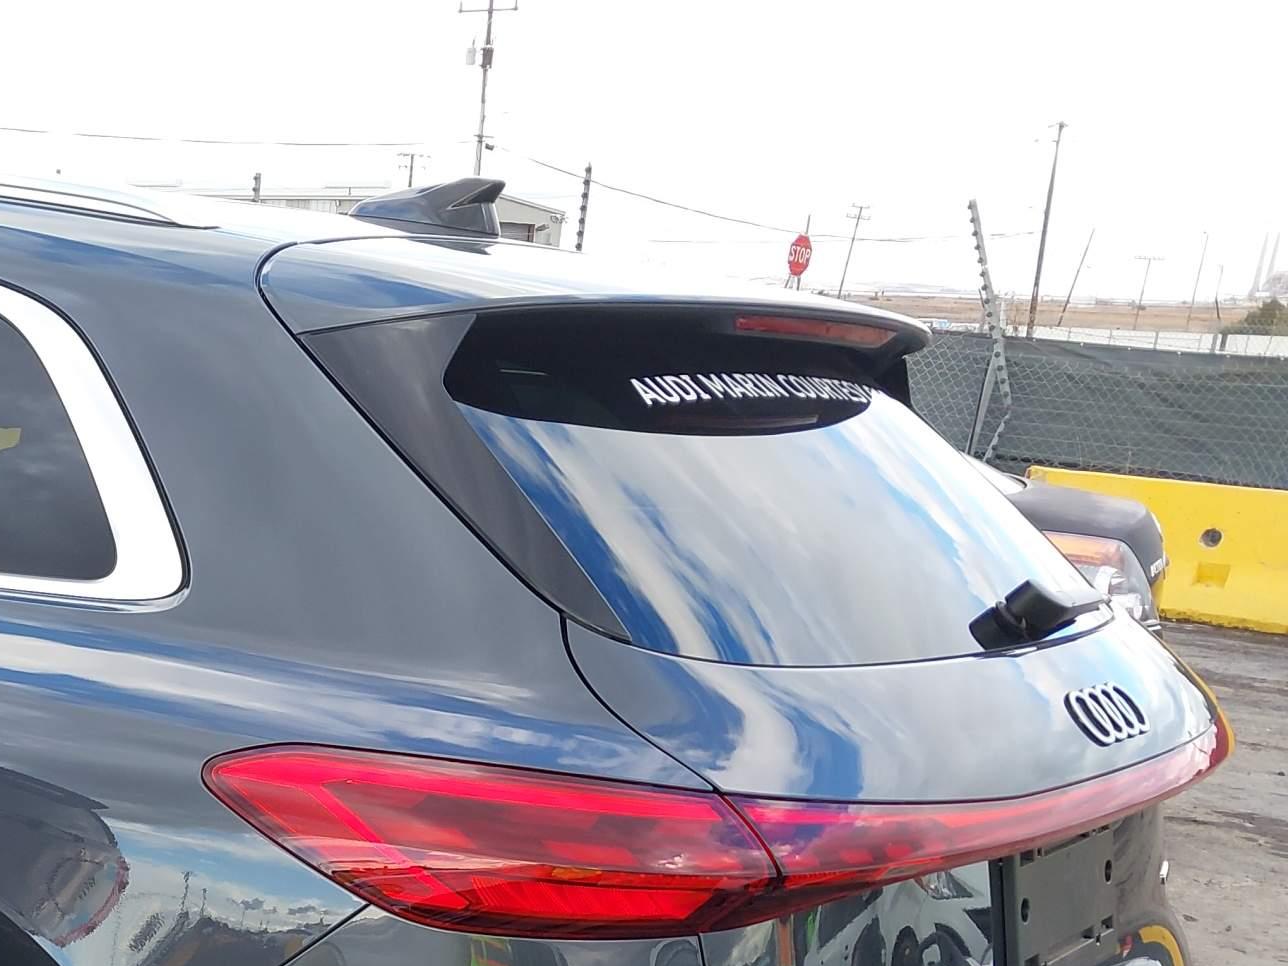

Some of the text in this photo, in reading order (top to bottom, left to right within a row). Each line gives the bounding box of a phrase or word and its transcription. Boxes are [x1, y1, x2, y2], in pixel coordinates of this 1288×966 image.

[789, 244, 811, 264] STOP
[630, 374, 712, 405] AUDI
[696, 373, 790, 398] MARIN
